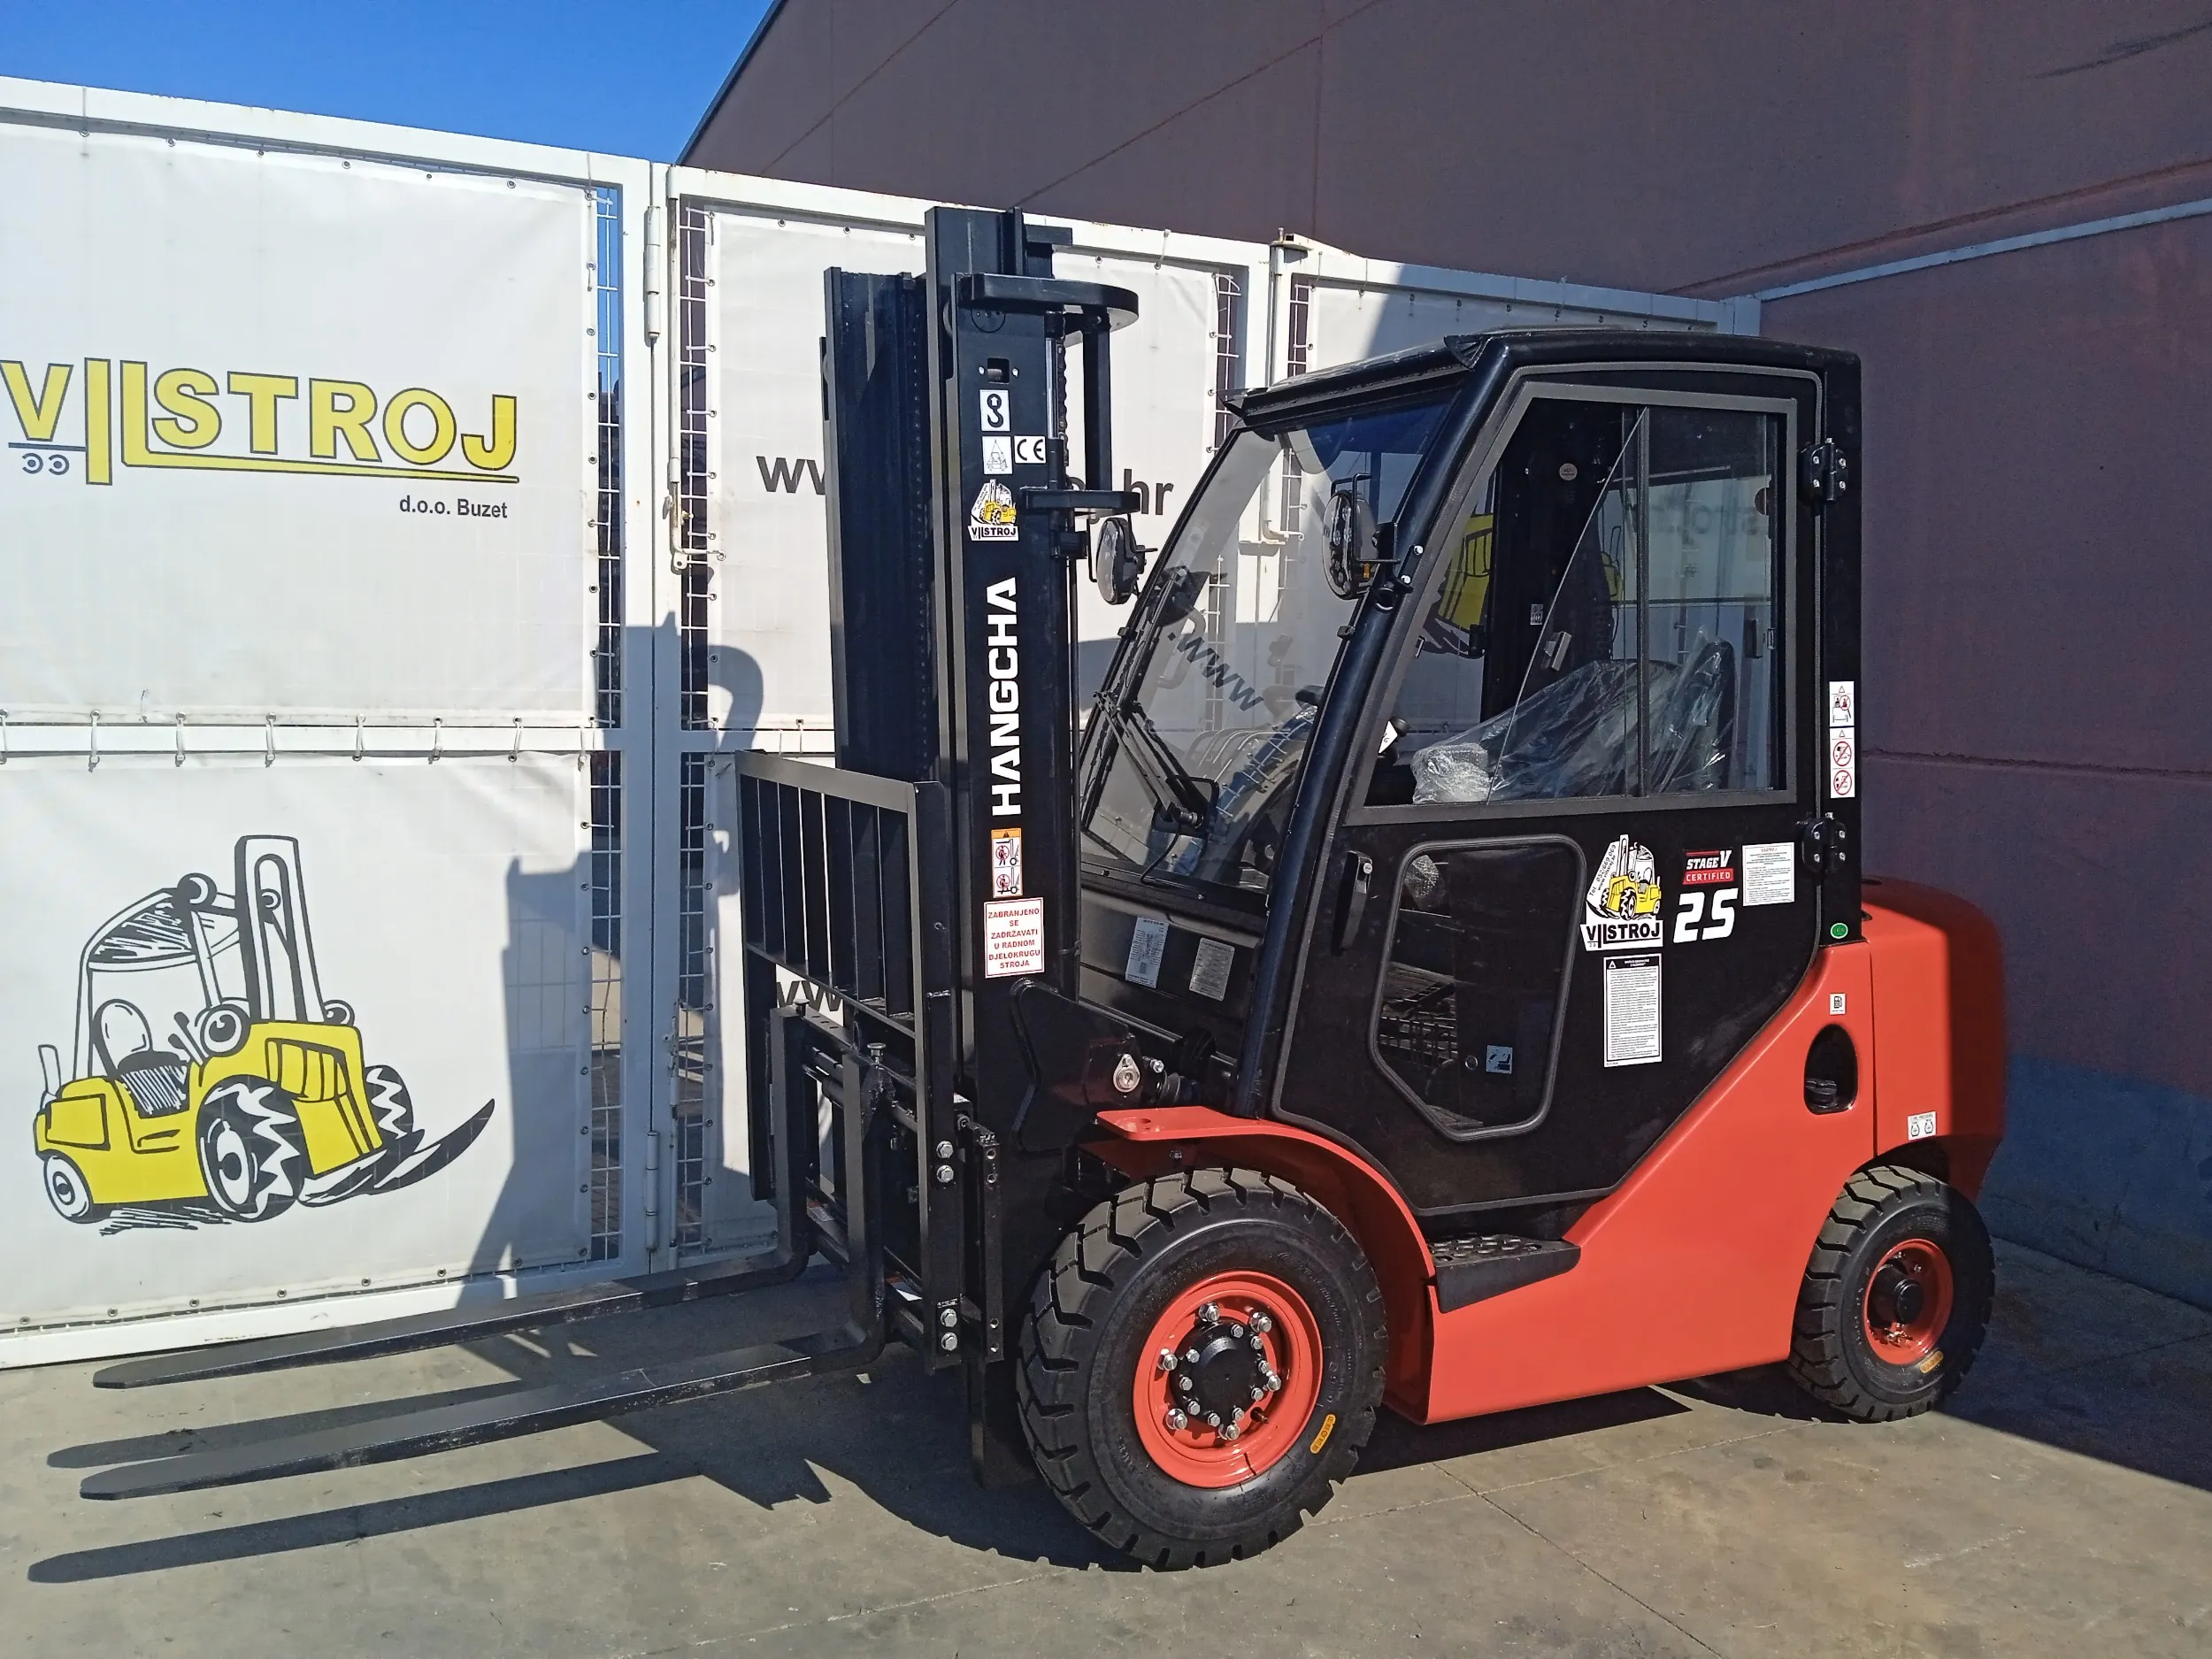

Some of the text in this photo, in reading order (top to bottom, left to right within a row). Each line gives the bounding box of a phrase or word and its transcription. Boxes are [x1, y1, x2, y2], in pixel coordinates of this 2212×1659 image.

[399, 495, 508, 518] d.o.o. Buzet
[971, 526, 1017, 539] VILSTROJ
[986, 576, 1022, 816] HANGCHA
[1686, 856, 1719, 870] STAGE
[1686, 872, 1731, 882] CERTIFIED
[988, 908, 1040, 918] ZABRANJENO
[1672, 887, 1739, 943] 25
[1586, 922, 1662, 949] VILSTROJ
[1002, 940, 1034, 949] RADNOM
[989, 949, 1040, 960] DJELOKRUGU
